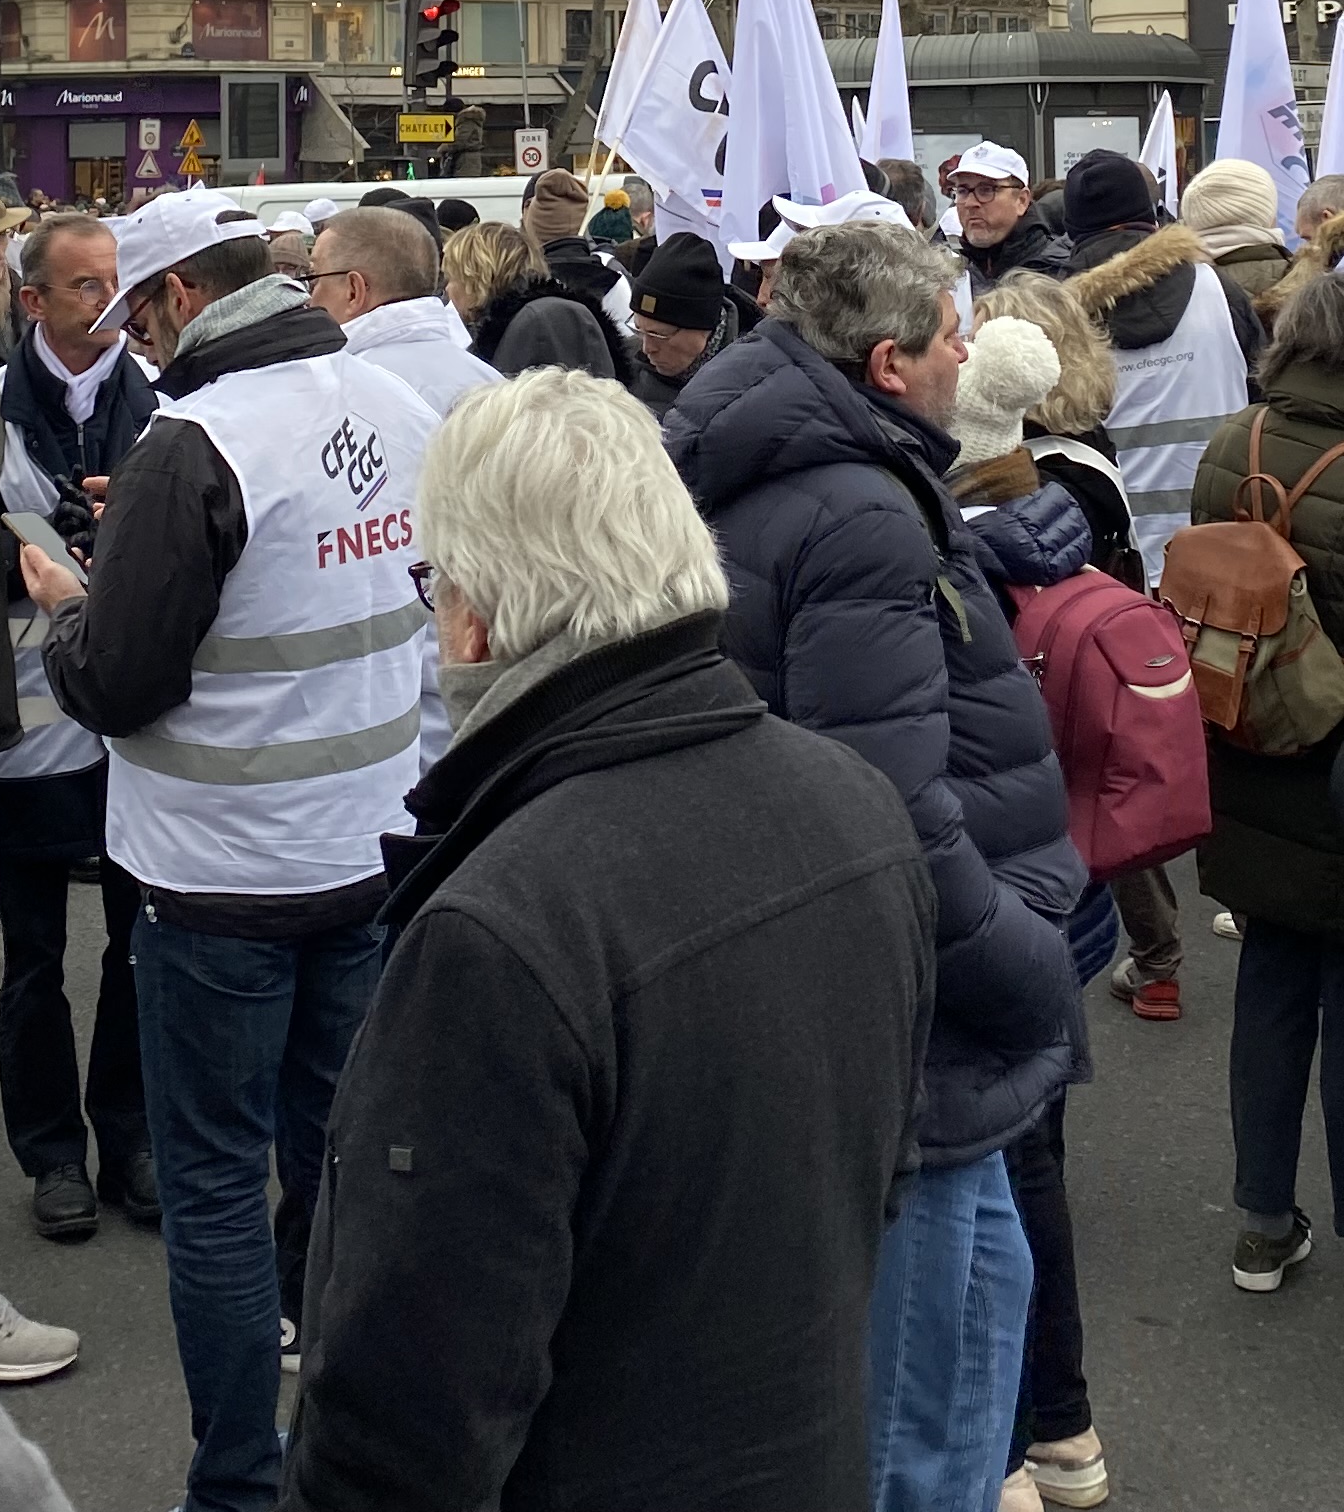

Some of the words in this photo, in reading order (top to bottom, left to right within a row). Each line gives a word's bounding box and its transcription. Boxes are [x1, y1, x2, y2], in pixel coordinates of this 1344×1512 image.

[199, 23, 262, 40] Marionnaud
[452, 67, 485, 77] ANGER
[55, 89, 123, 107] Marionnaud
[400, 123, 444, 134] CHATELET
[525, 152, 538, 162] 30
[1118, 351, 1195, 373] w.cfecgc.org
[321, 416, 358, 480] CFE
[347, 431, 383, 496] CGC
[317, 509, 413, 569] FNECS
